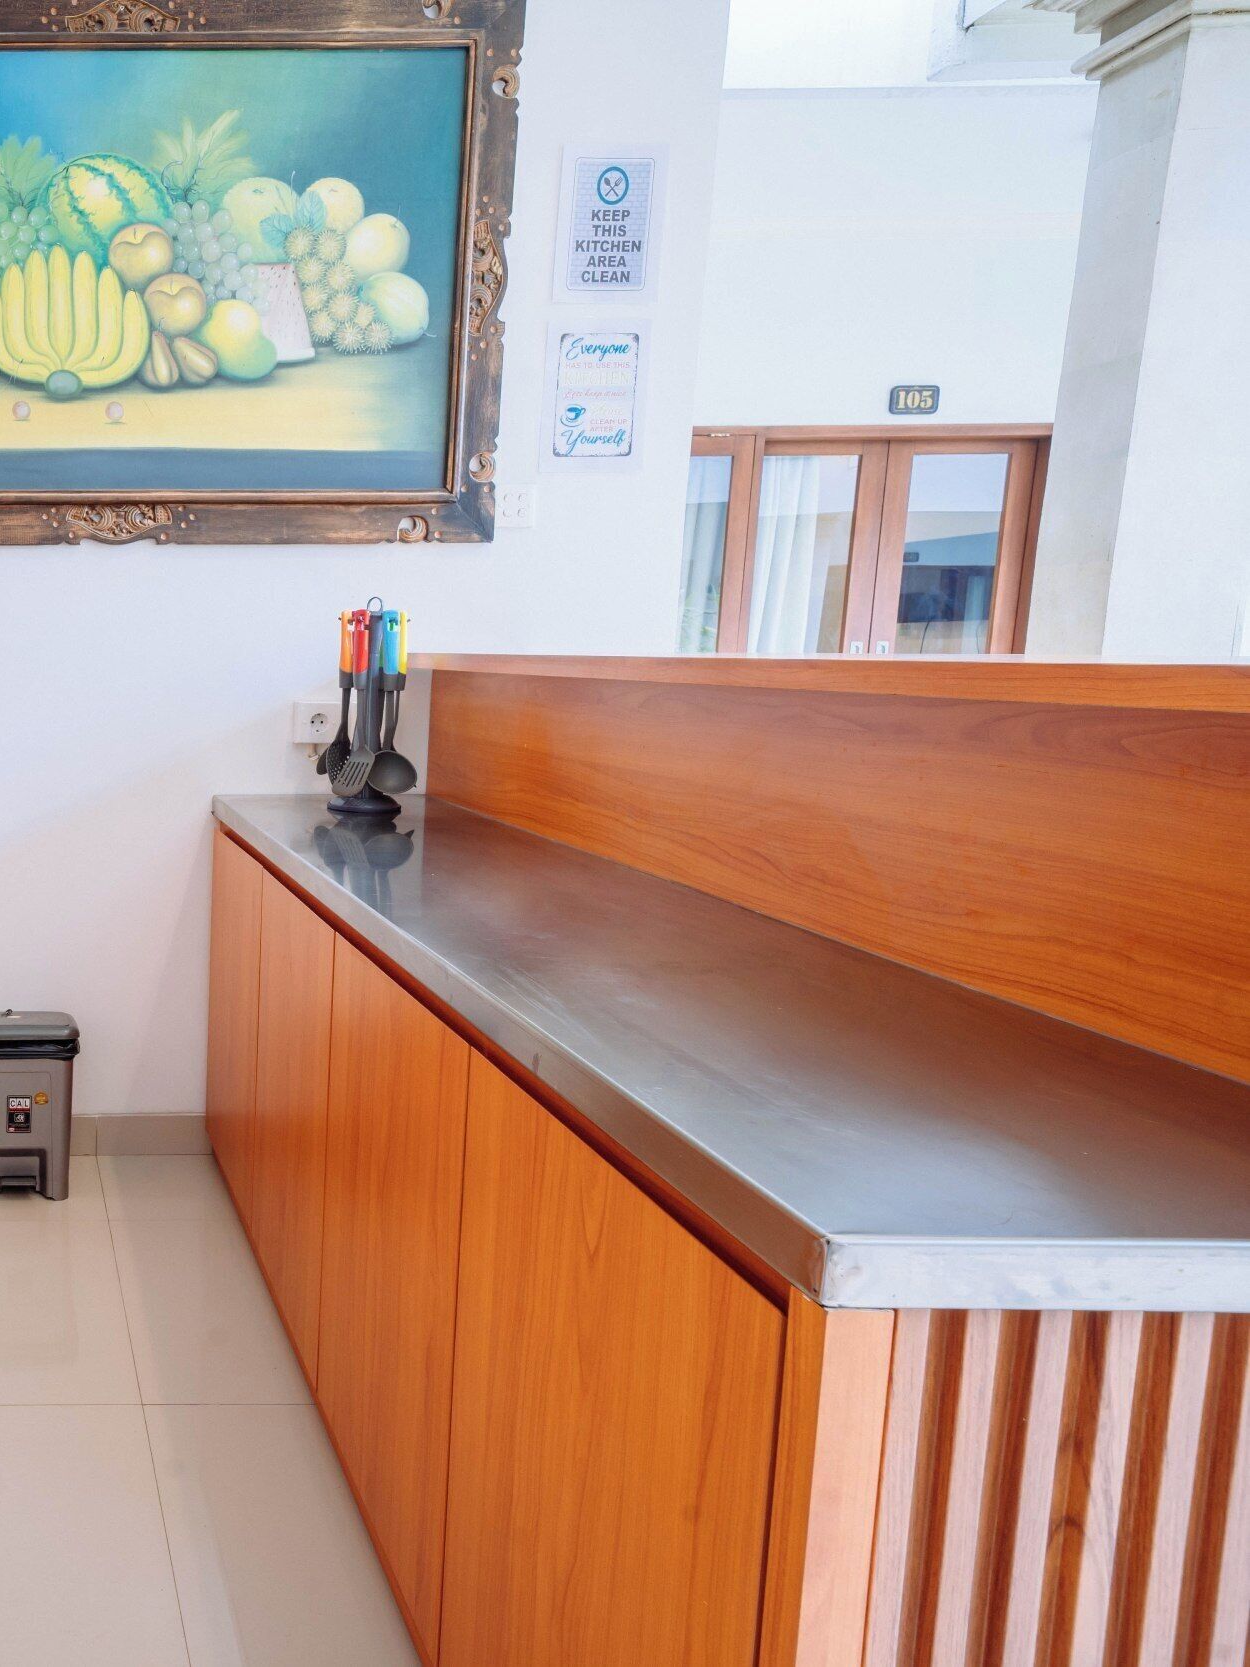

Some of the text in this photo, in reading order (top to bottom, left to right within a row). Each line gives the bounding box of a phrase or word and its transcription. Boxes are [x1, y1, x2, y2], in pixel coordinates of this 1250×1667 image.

[591, 209, 631, 222] KEEP
[592, 224, 627, 237] THIS
[575, 240, 642, 253] KITCHEN
[586, 255, 627, 268] AREA
[581, 270, 631, 283] CLEAN
[565, 337, 630, 361] Everyone
[897, 390, 933, 409] 105
[561, 428, 626, 456] Yourself
